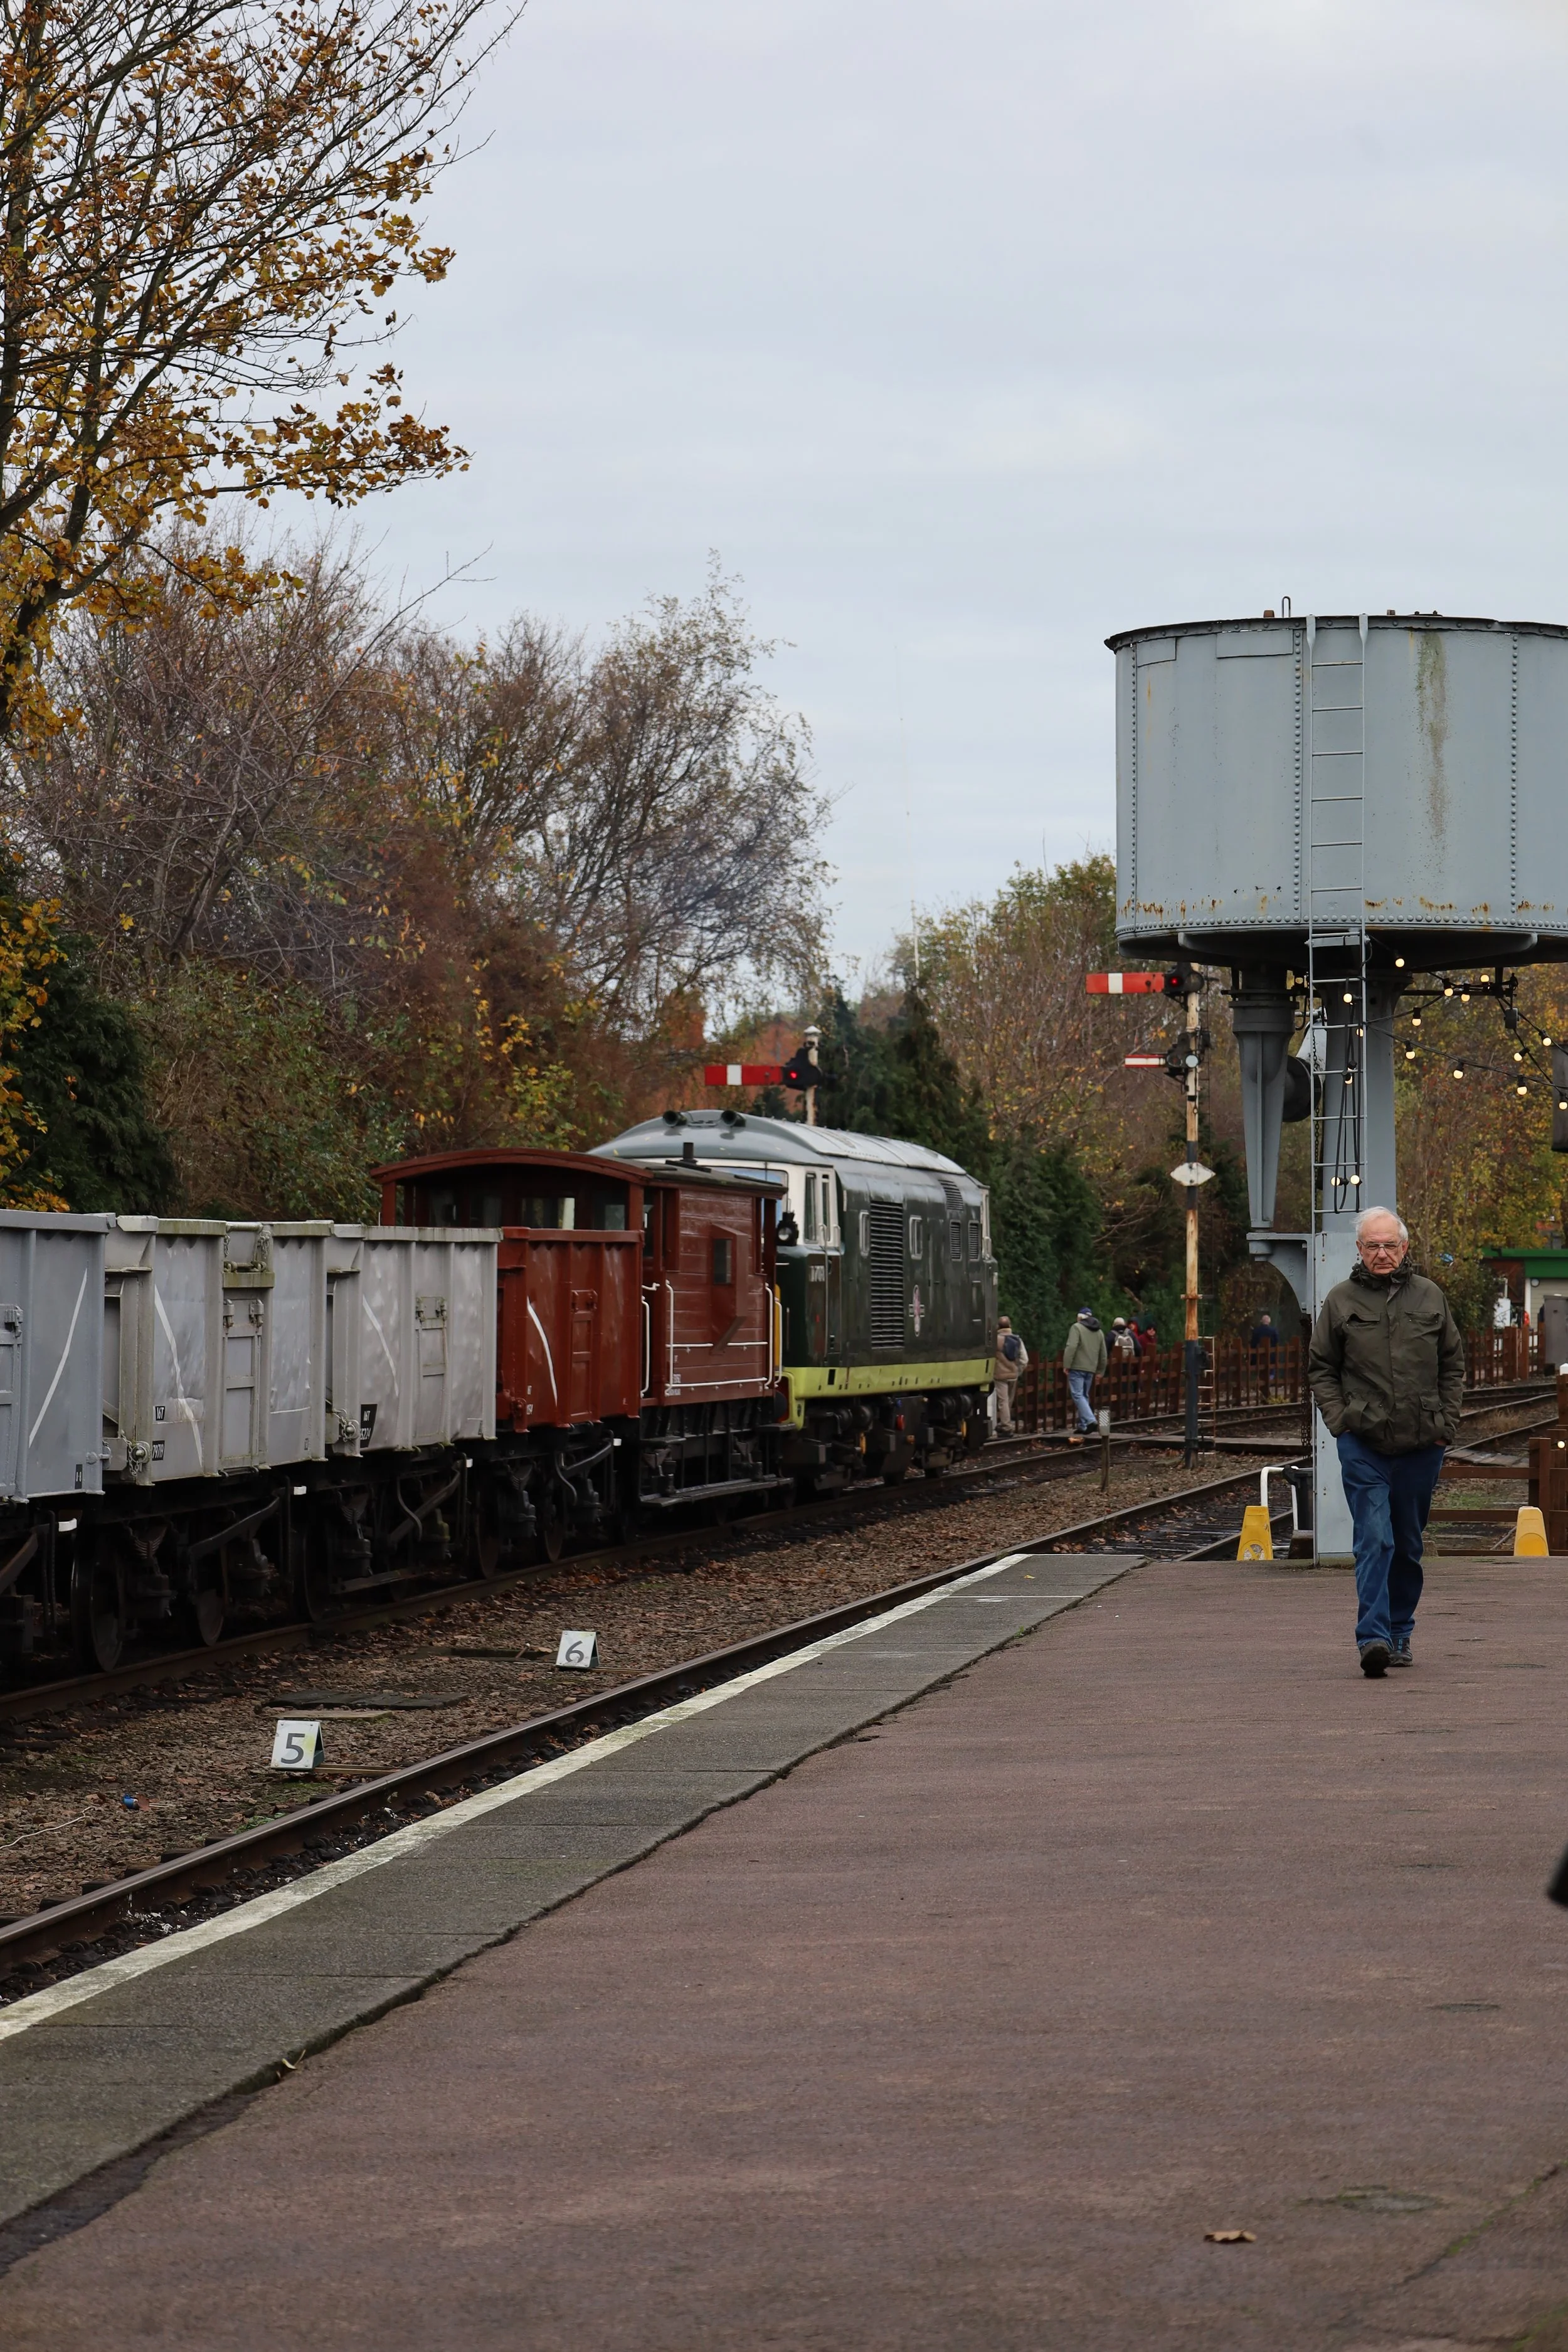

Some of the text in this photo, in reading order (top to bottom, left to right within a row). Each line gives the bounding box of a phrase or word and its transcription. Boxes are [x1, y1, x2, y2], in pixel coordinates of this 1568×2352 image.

[156, 1407, 164, 1419] 16T
[565, 1640, 584, 1663] 6
[280, 1733, 305, 1764] 5
